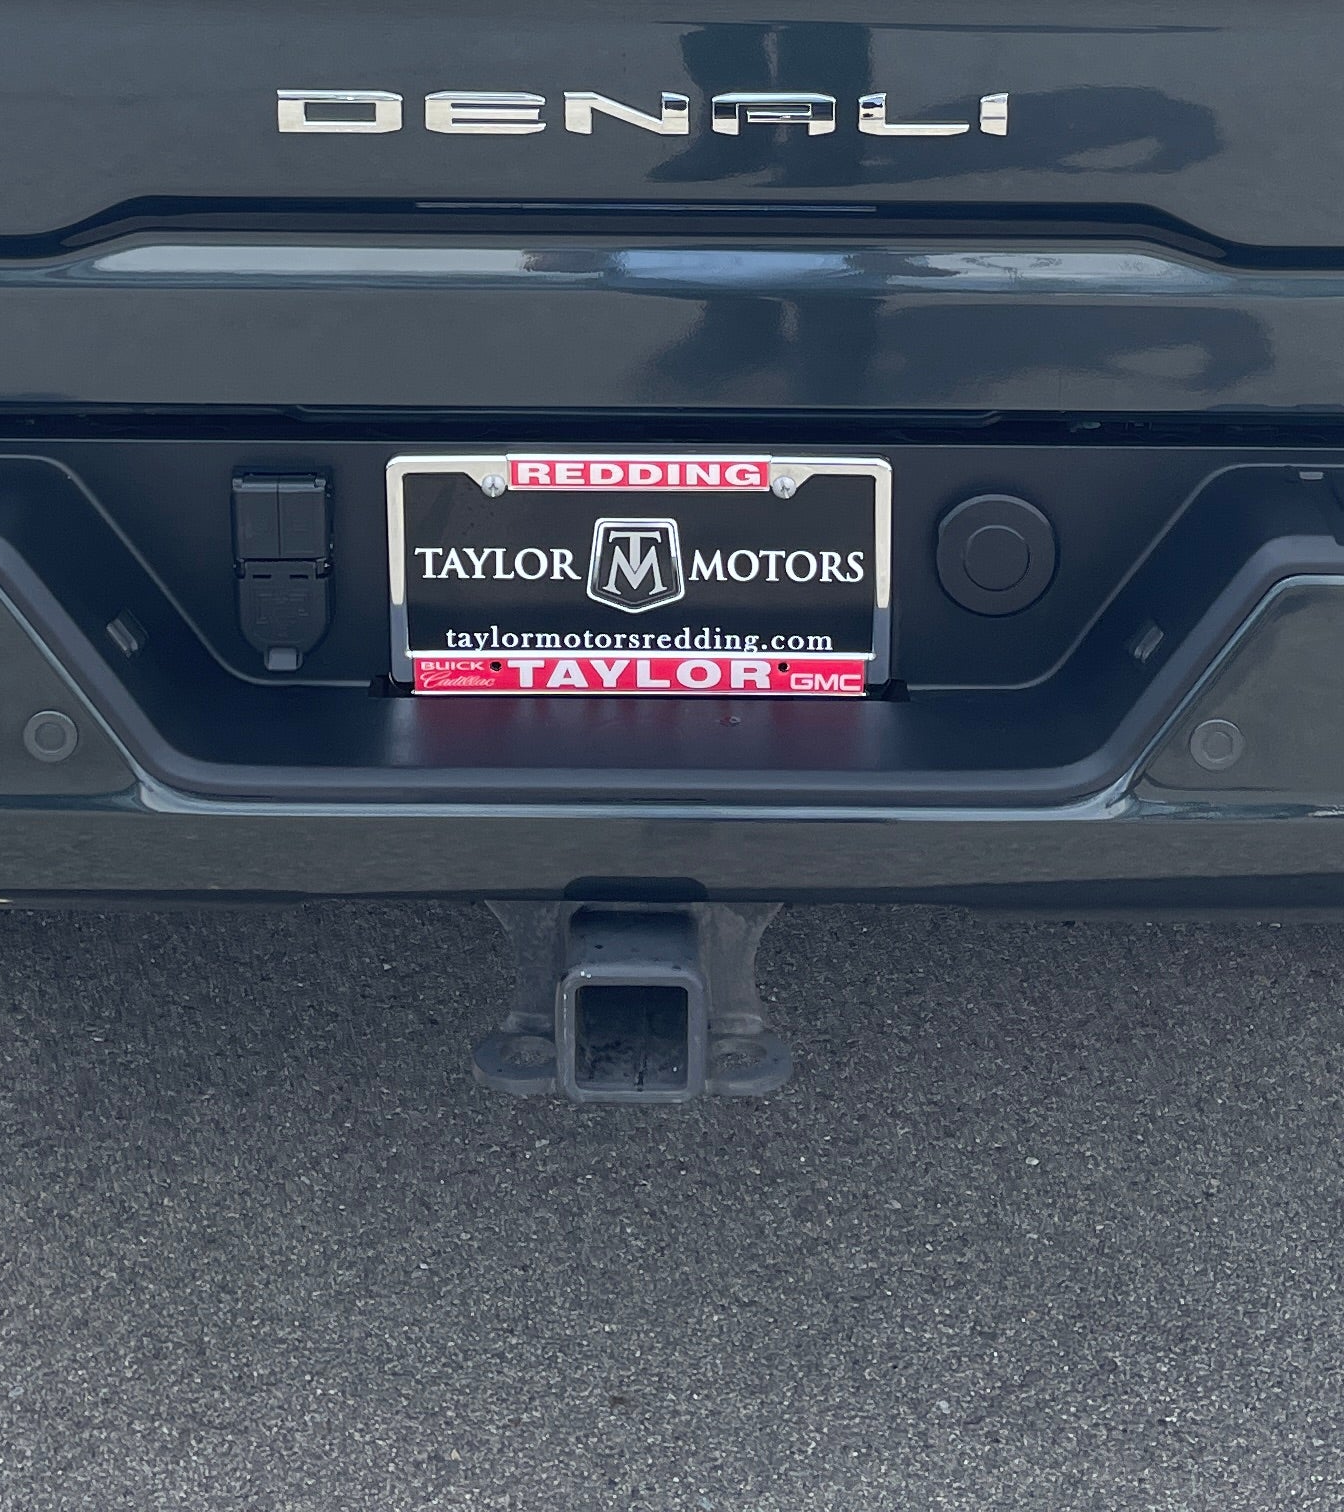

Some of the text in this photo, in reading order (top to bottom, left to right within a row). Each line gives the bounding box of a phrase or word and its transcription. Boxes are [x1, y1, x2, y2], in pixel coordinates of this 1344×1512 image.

[276, 89, 1010, 137] DENALI
[517, 462, 761, 486] REDDING
[414, 547, 865, 584] TAYLOR MOTORS
[445, 626, 834, 653] taylormotorsredding.com
[420, 661, 485, 672] BUICK
[507, 659, 772, 690] TAYLOR
[789, 673, 862, 692] GMC
